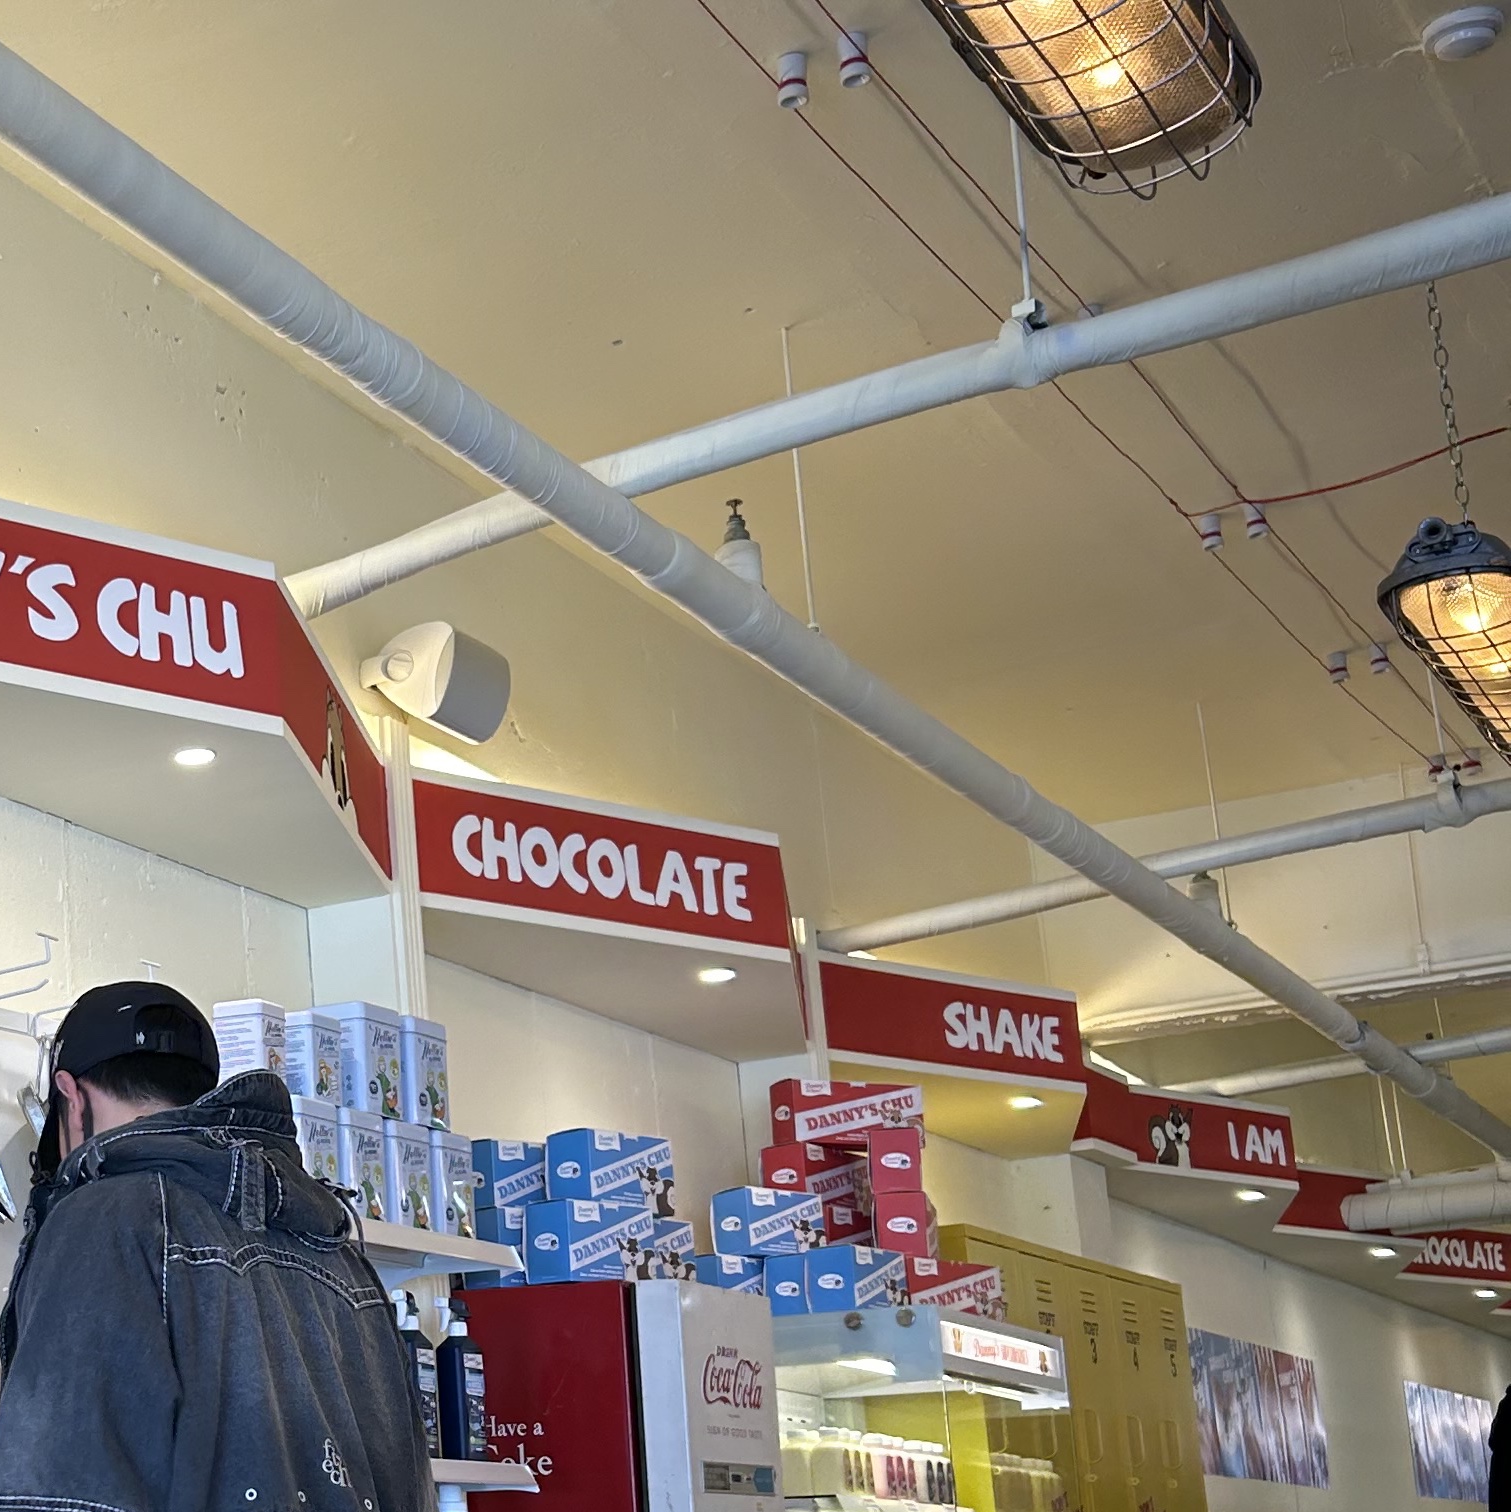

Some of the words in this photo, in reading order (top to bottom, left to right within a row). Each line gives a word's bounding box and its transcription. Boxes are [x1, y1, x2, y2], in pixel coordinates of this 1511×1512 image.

[96, 577, 244, 678] CHU
[451, 814, 753, 922] CHOCOLATE
[942, 1001, 1065, 1063] SHAKE
[806, 1103, 879, 1132] DANNY'S
[647, 1147, 671, 1167] CHU
[1227, 1121, 1238, 1159] I
[1245, 1124, 1288, 1167] AM
[573, 1227, 627, 1262] DANNY'S
[627, 1215, 653, 1237] CHU
[1412, 1237, 1506, 1271] HOCOLATE
[533, 1422, 544, 1436] a
